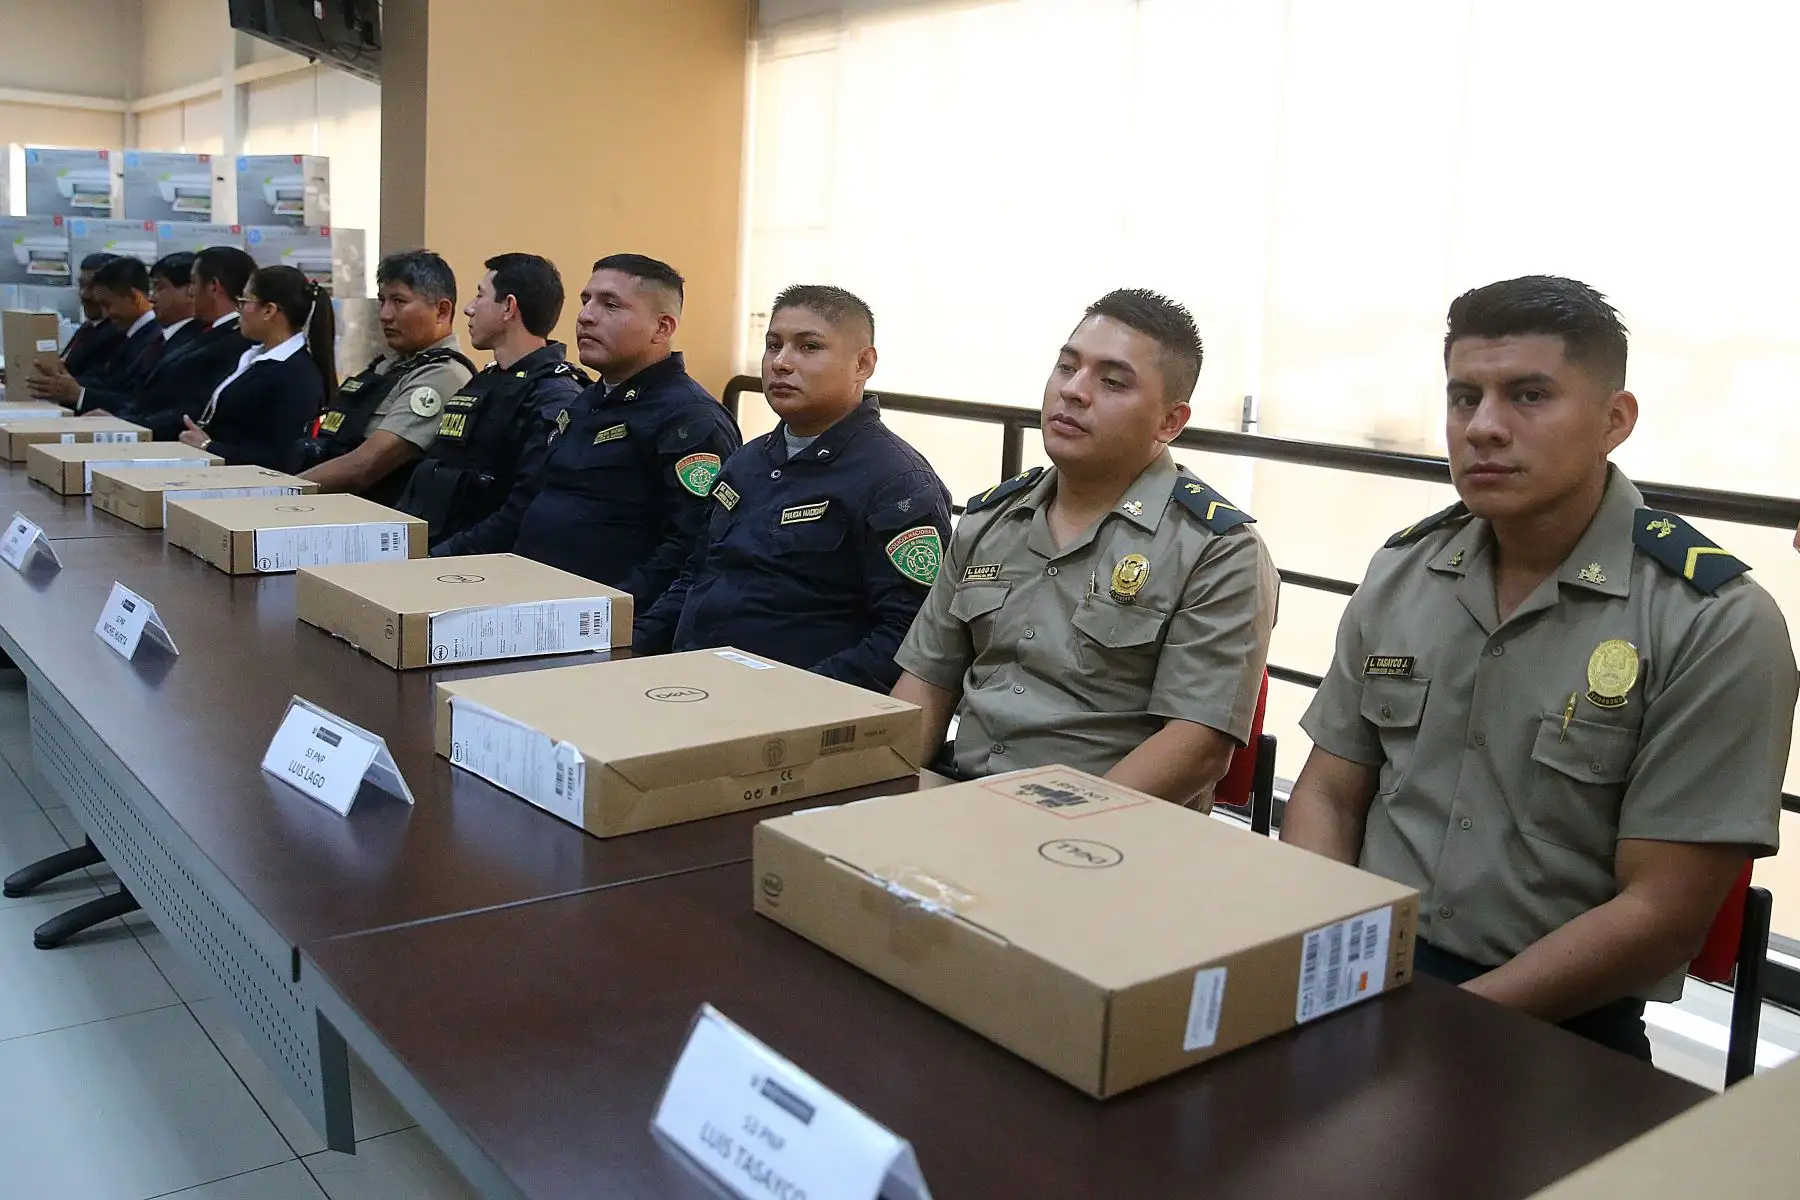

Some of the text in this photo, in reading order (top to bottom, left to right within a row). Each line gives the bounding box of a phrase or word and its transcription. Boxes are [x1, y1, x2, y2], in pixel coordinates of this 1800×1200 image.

[785, 510, 802, 520] POLICIA
[888, 534, 909, 553] POLICIA
[908, 529, 935, 539] NACIONAL
[1376, 658, 1403, 668] TASAYCO
[305, 747, 326, 763] S3 PNP
[288, 760, 326, 788] LUIS LAGO
[1056, 842, 1108, 866] DELL
[699, 1119, 734, 1160] LUIS
